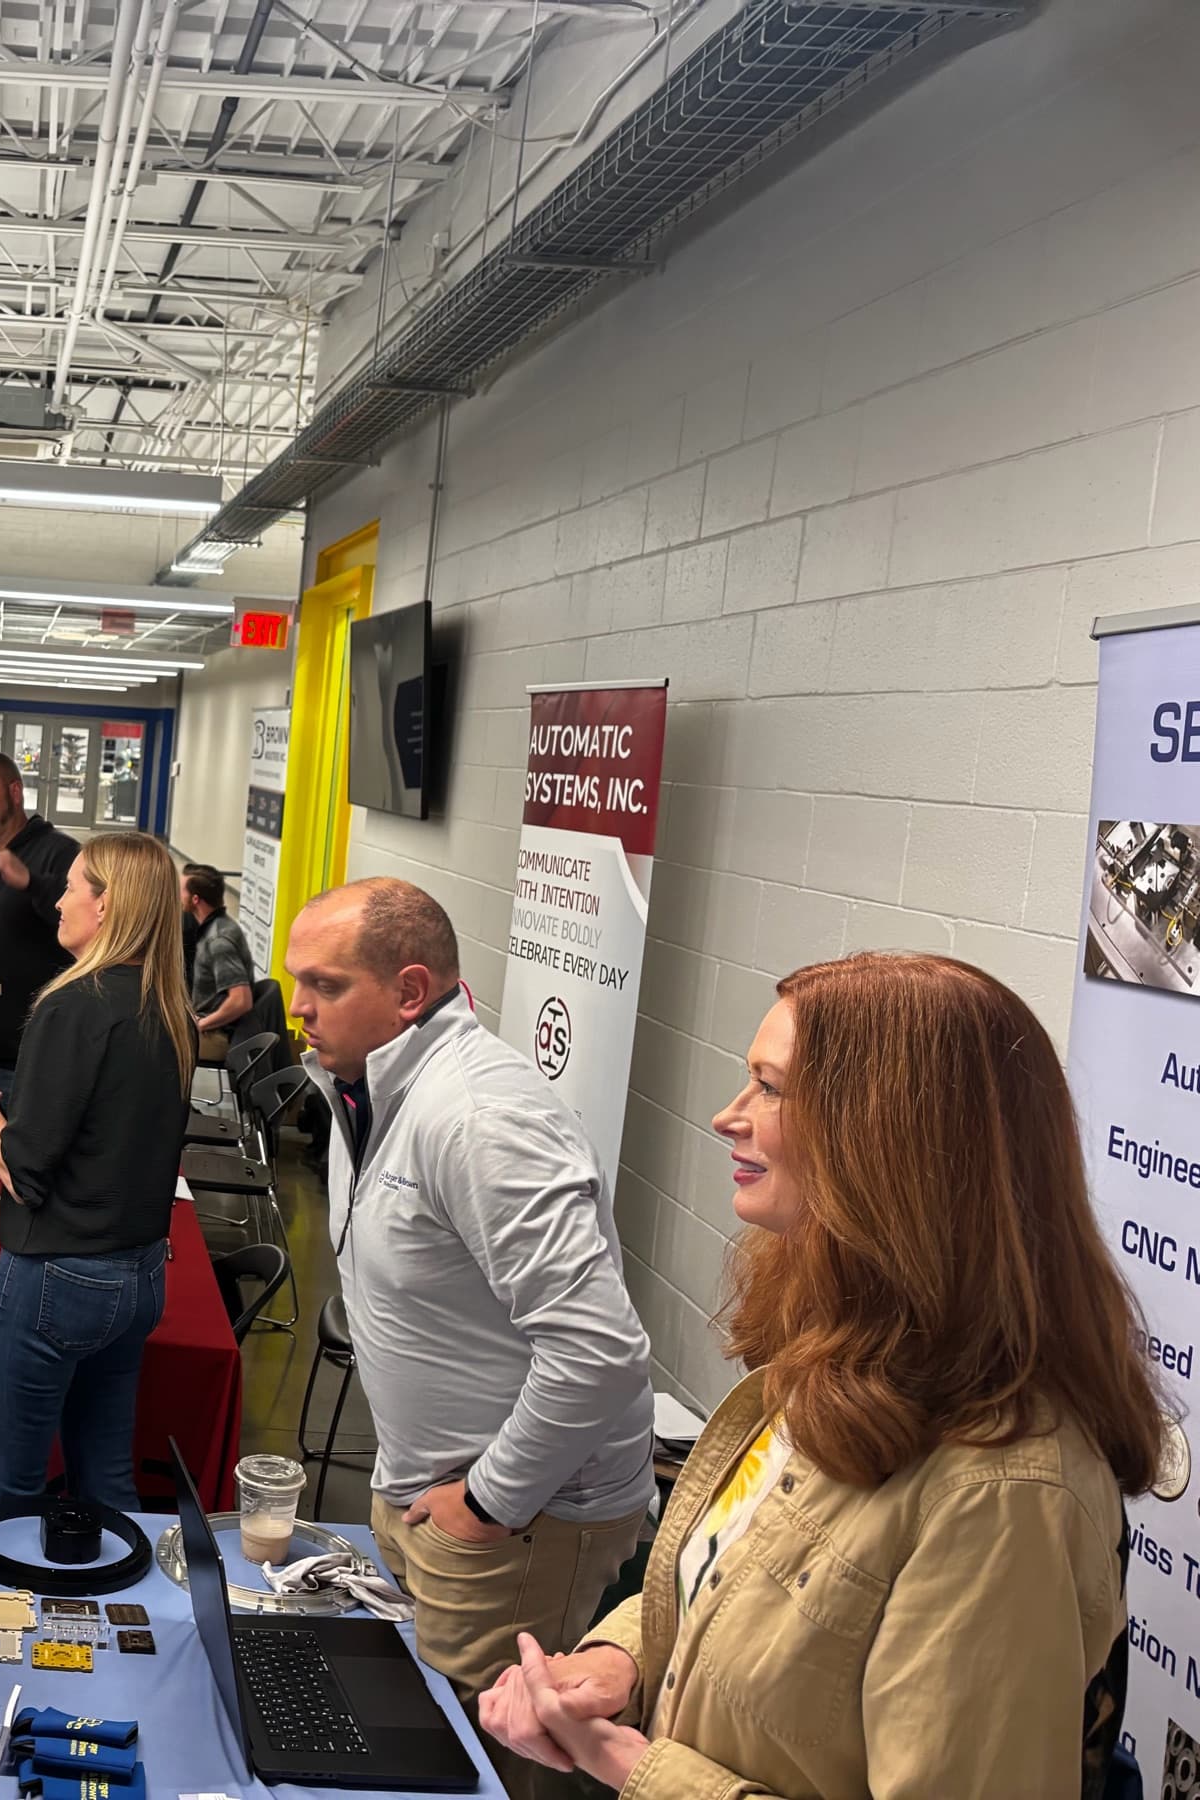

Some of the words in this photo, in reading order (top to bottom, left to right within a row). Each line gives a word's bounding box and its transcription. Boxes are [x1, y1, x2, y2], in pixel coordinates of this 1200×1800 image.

[242, 614, 282, 647] EXIT
[529, 725, 633, 759] AUTOMATIC
[524, 771, 601, 814] SYSTEMS,
[606, 777, 648, 814] INC.
[541, 883, 601, 917] INTENTION
[561, 919, 603, 950] BOLDLY
[563, 952, 597, 982] EVERY
[599, 964, 630, 991] DAY
[1122, 1220, 1177, 1272] CNC
